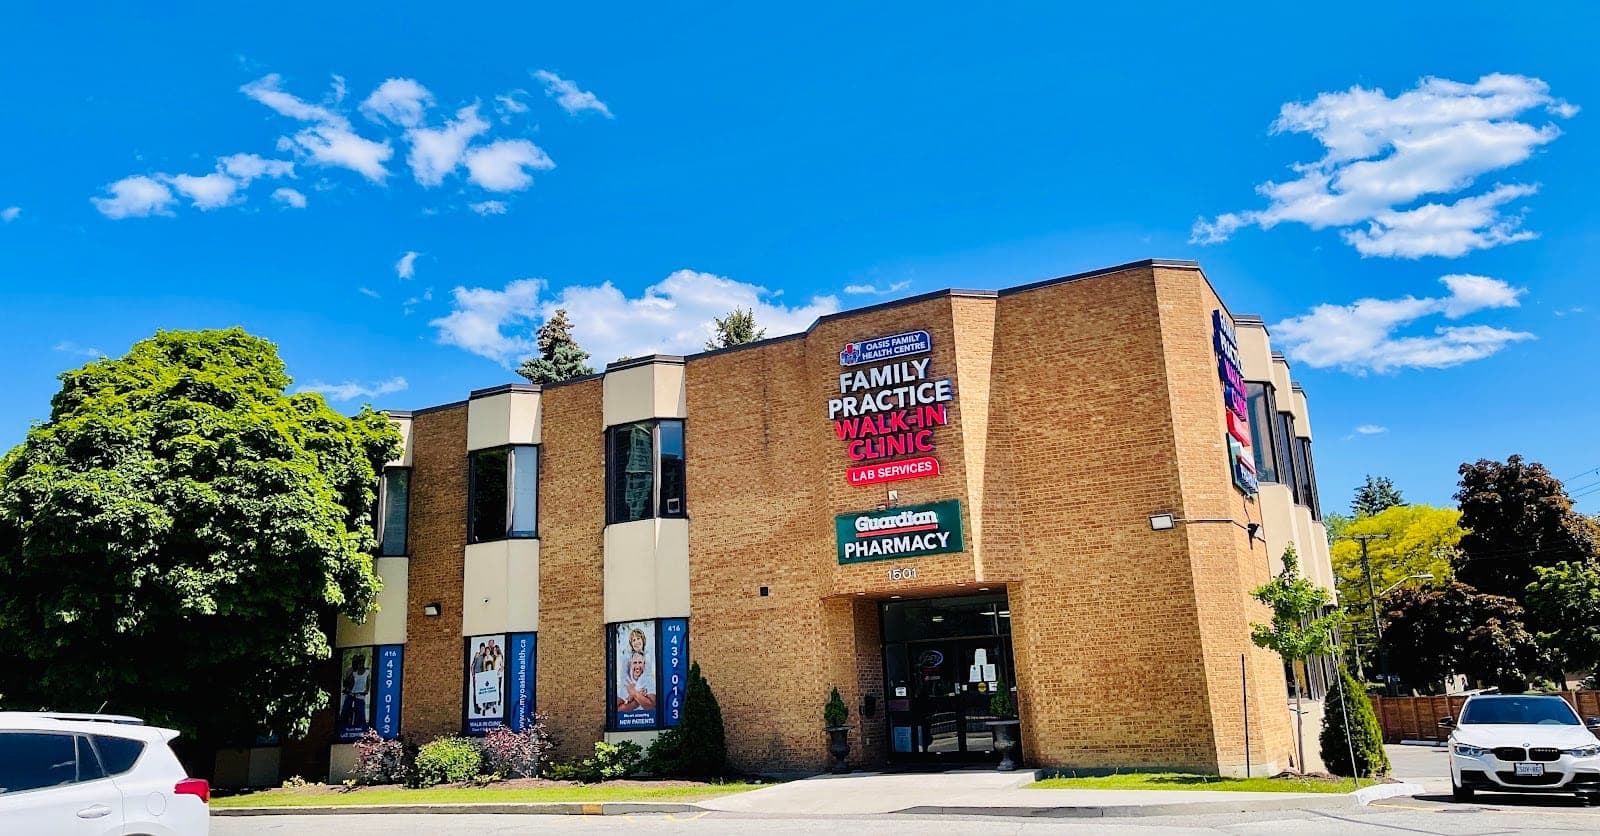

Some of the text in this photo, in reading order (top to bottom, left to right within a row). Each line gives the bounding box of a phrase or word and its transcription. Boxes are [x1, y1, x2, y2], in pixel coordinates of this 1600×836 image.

[861, 341, 926, 360] HEALTH CENTRE
[866, 334, 921, 351] OASIS FAMILY
[840, 358, 930, 394] FAMILY
[828, 379, 953, 420] PRACTICE
[834, 403, 946, 440] WALK-IN
[847, 429, 935, 461] CLINIC
[852, 461, 933, 482] LAB SERVICES
[855, 510, 938, 532] Guardian
[844, 531, 950, 559] PHARMACY
[887, 567, 918, 581] 1501
